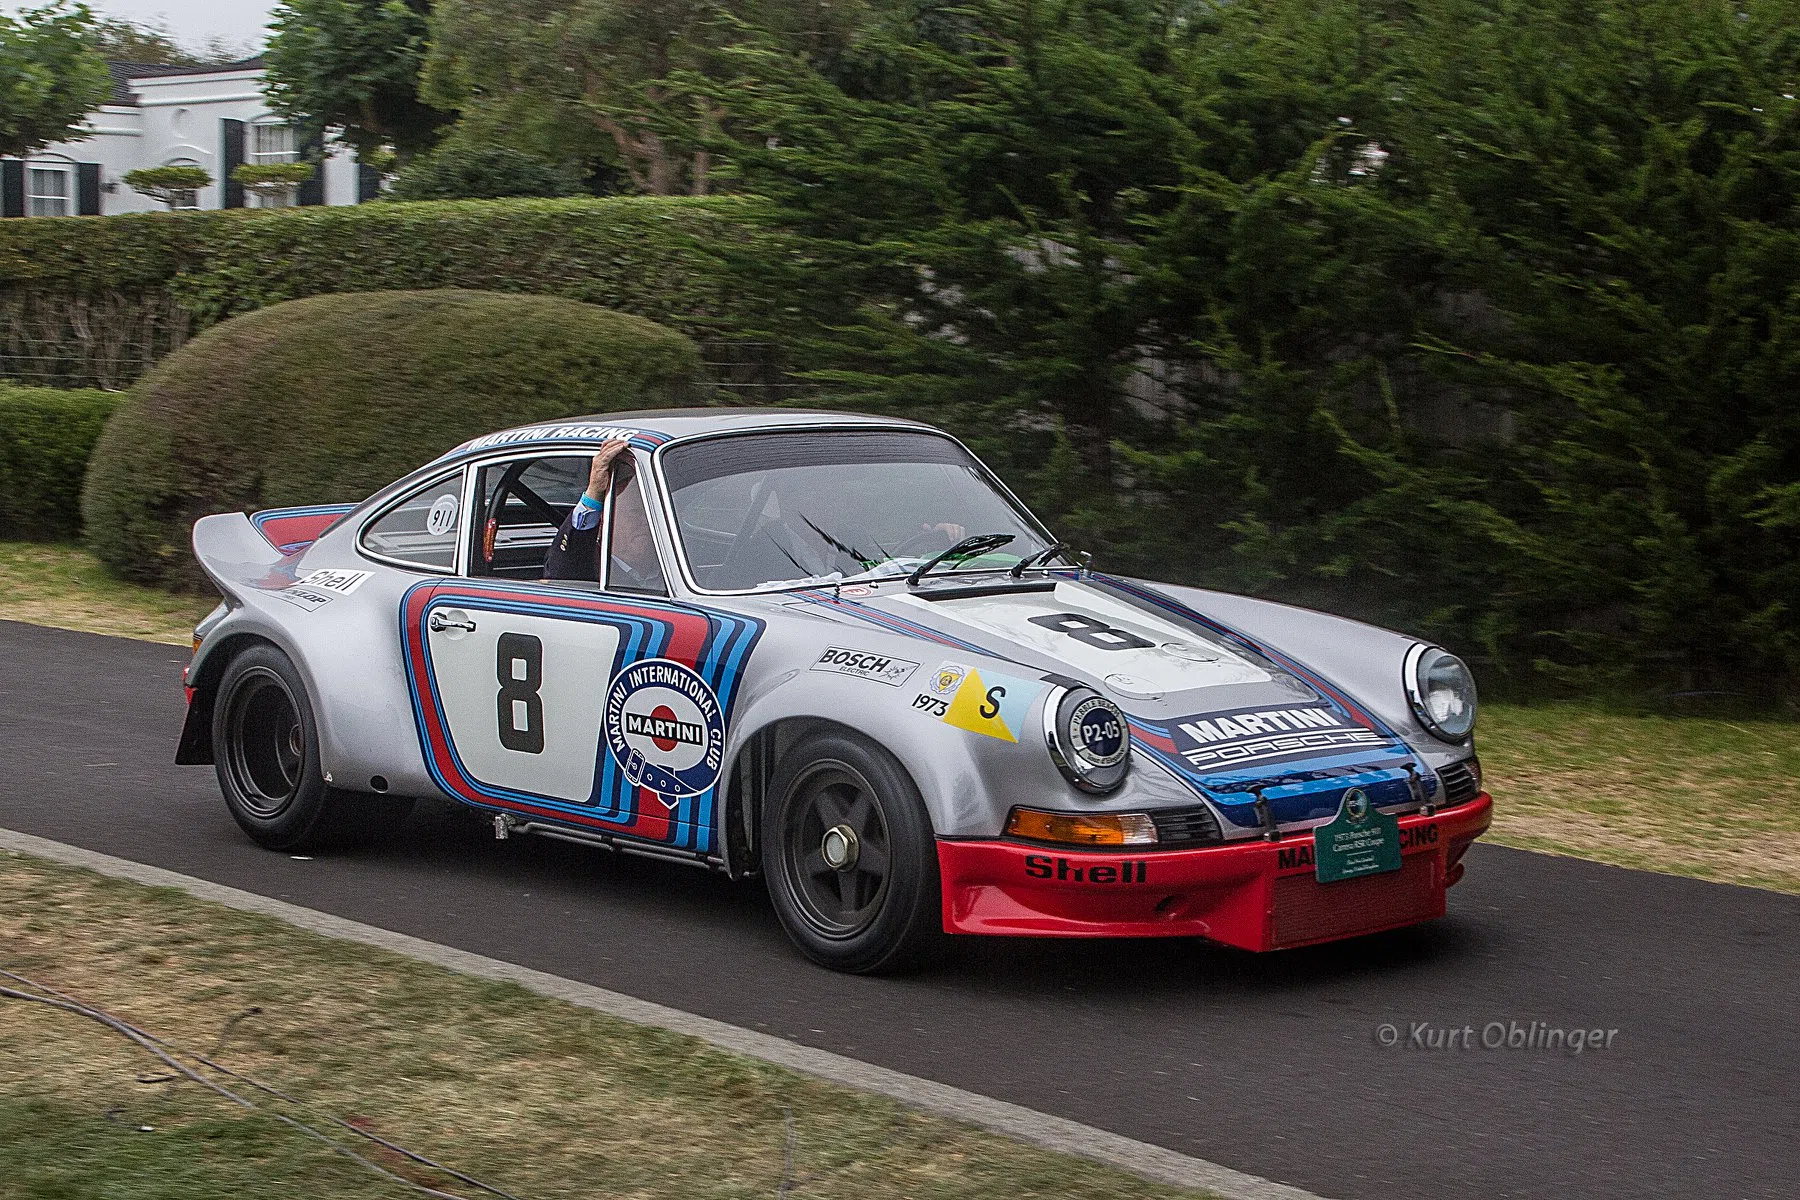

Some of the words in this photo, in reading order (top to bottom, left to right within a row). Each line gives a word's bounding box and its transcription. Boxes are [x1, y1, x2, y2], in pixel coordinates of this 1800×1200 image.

[467, 428, 552, 451] MARTINI
[551, 426, 639, 442] RACING
[432, 510, 452, 527] 911
[300, 571, 365, 591] Shell
[1027, 612, 1156, 652] 8
[818, 649, 891, 673] BOSCH
[839, 666, 870, 677] ELECTRIC
[497, 632, 544, 754] 8
[911, 693, 949, 717] 1973
[979, 686, 1006, 719] S
[609, 682, 628, 753] MARTINI
[628, 666, 717, 723] INTERNATIONAL
[706, 728, 722, 771] CLUB
[628, 715, 701, 743] MARTINI
[1082, 720, 1120, 743] P2-05
[1178, 707, 1341, 744] MARTINI
[1185, 731, 1382, 765] PORSCHE
[1399, 823, 1439, 849] CING
[1025, 855, 1147, 883] Shell
